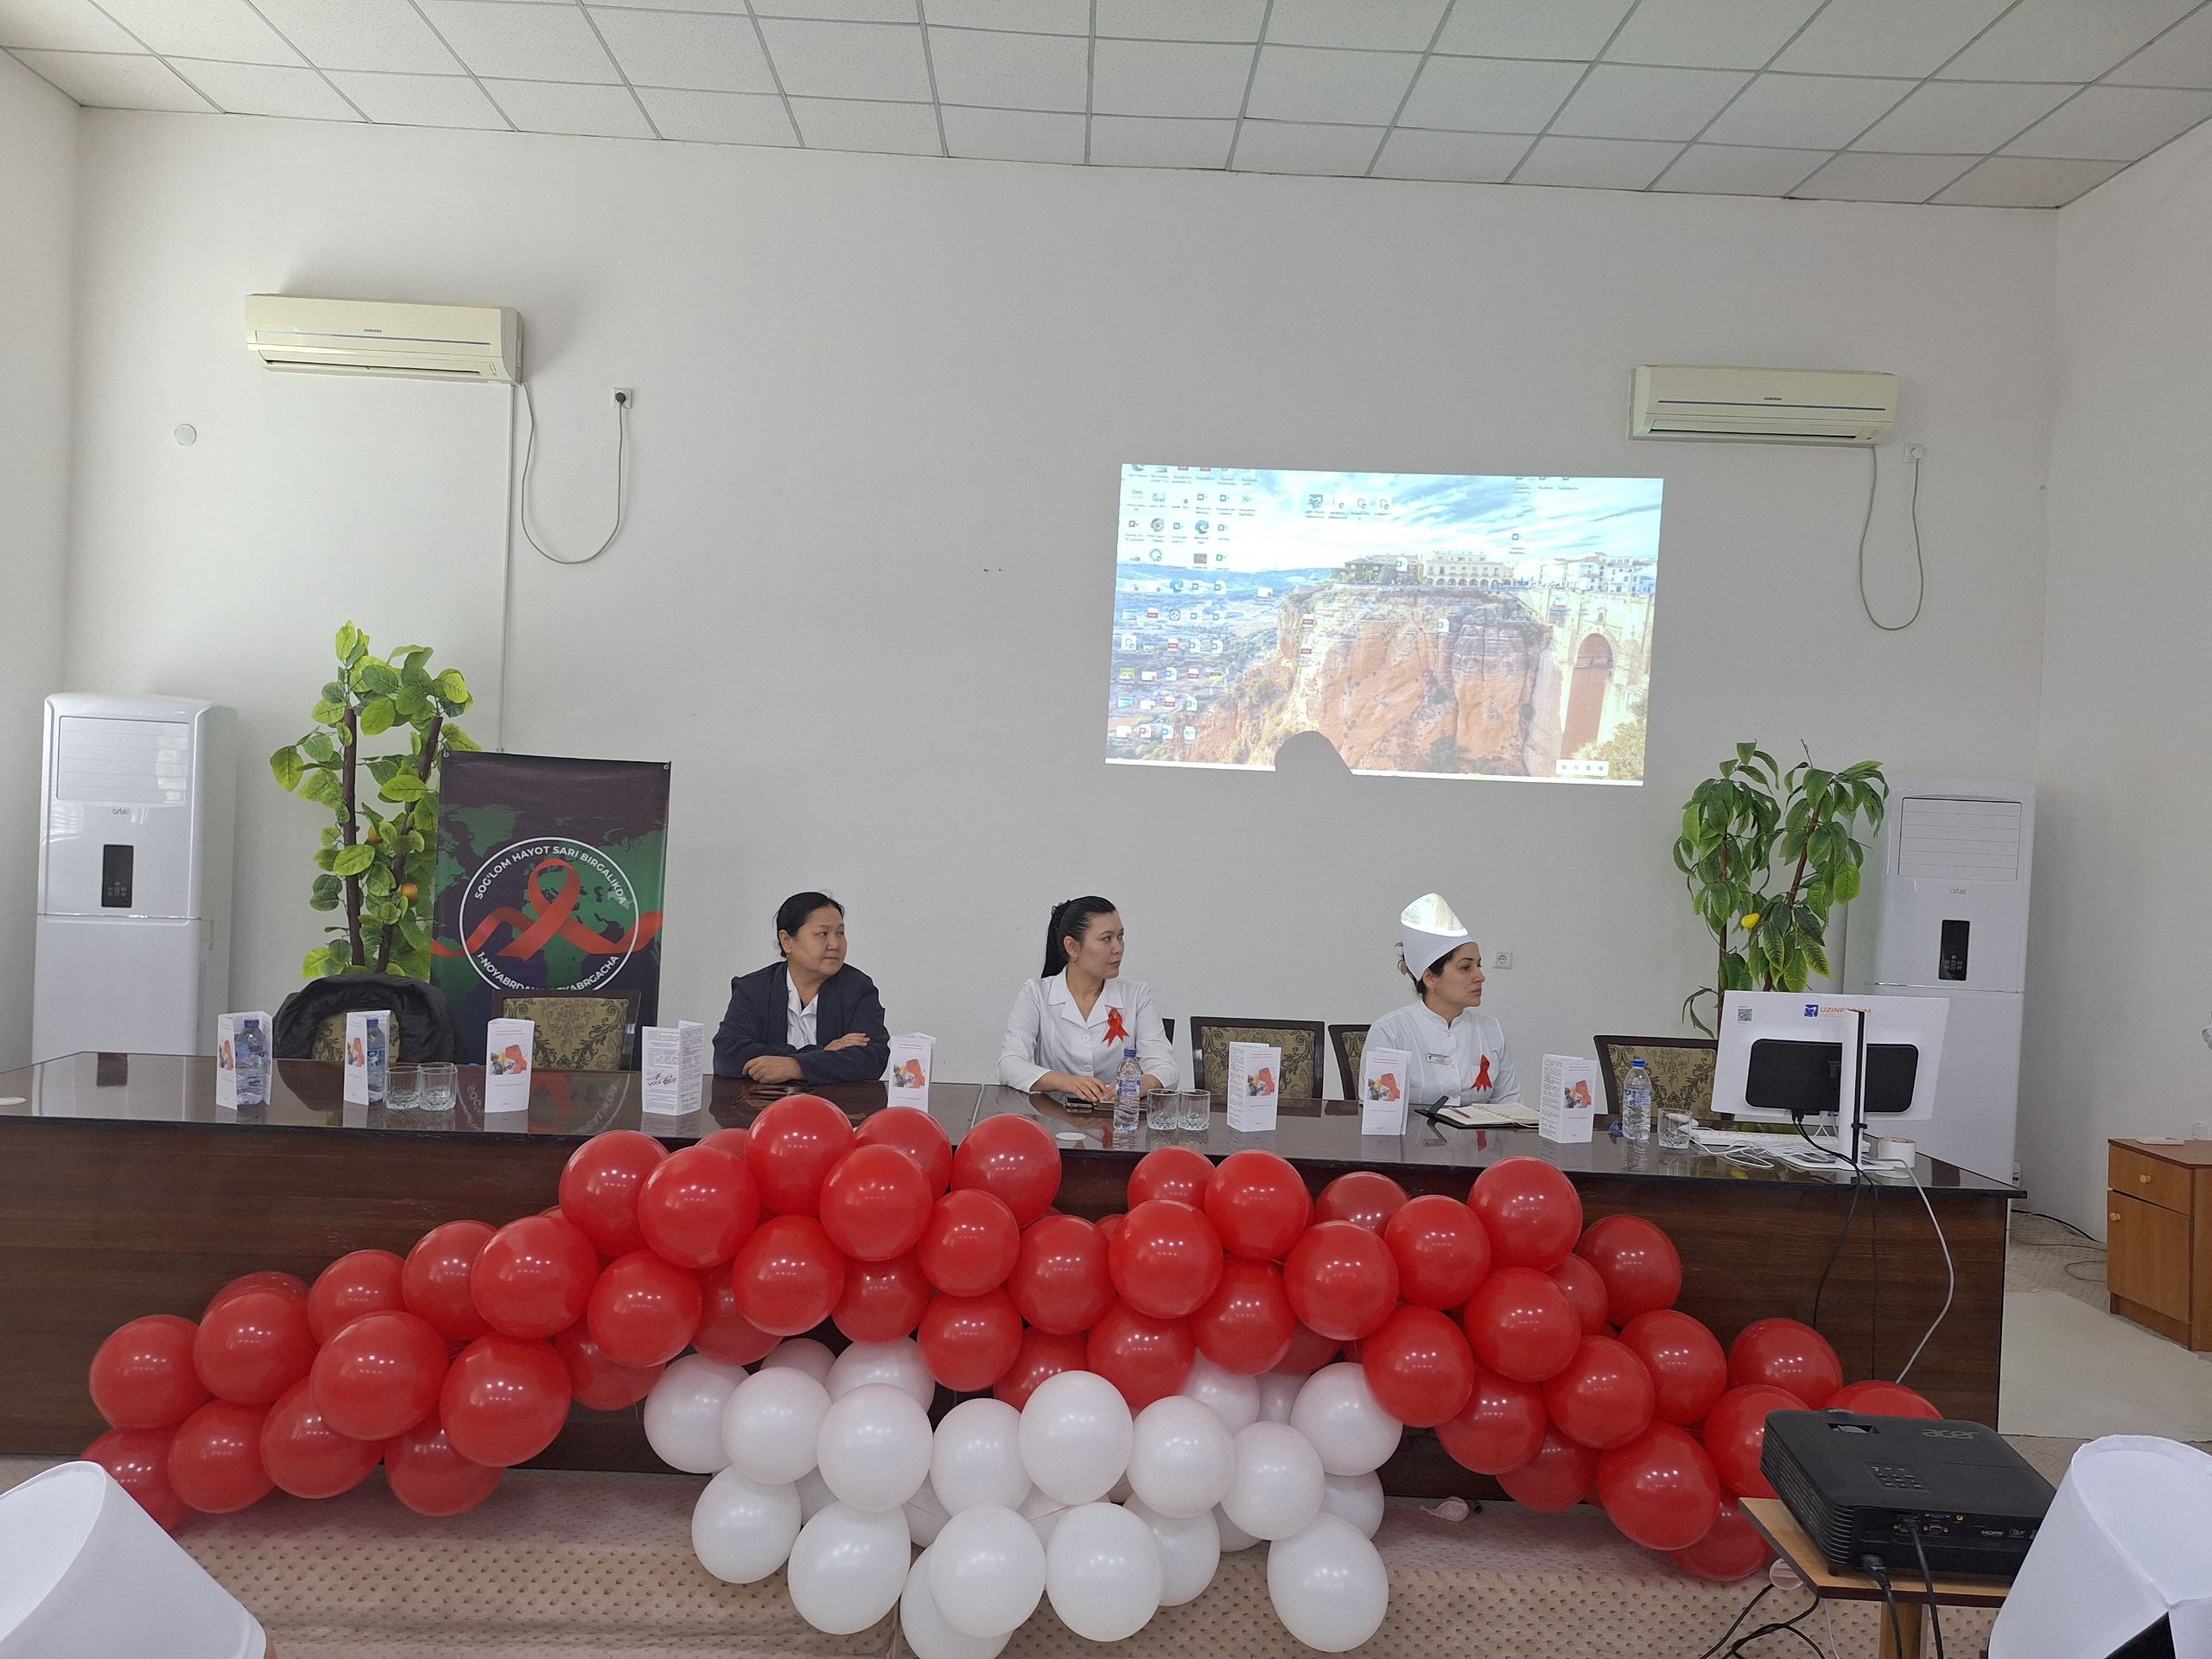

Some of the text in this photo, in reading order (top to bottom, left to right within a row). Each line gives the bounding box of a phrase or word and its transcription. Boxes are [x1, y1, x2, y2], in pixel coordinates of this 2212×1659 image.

[474, 845, 626, 905] SOG'LOM HAYOT SARI BIRGALIKDA
[476, 950, 620, 990] 1-NOYABRD ABRGACHA
[1820, 1006, 1872, 1014] UZINFM
[1921, 1428, 1979, 1440] acer
